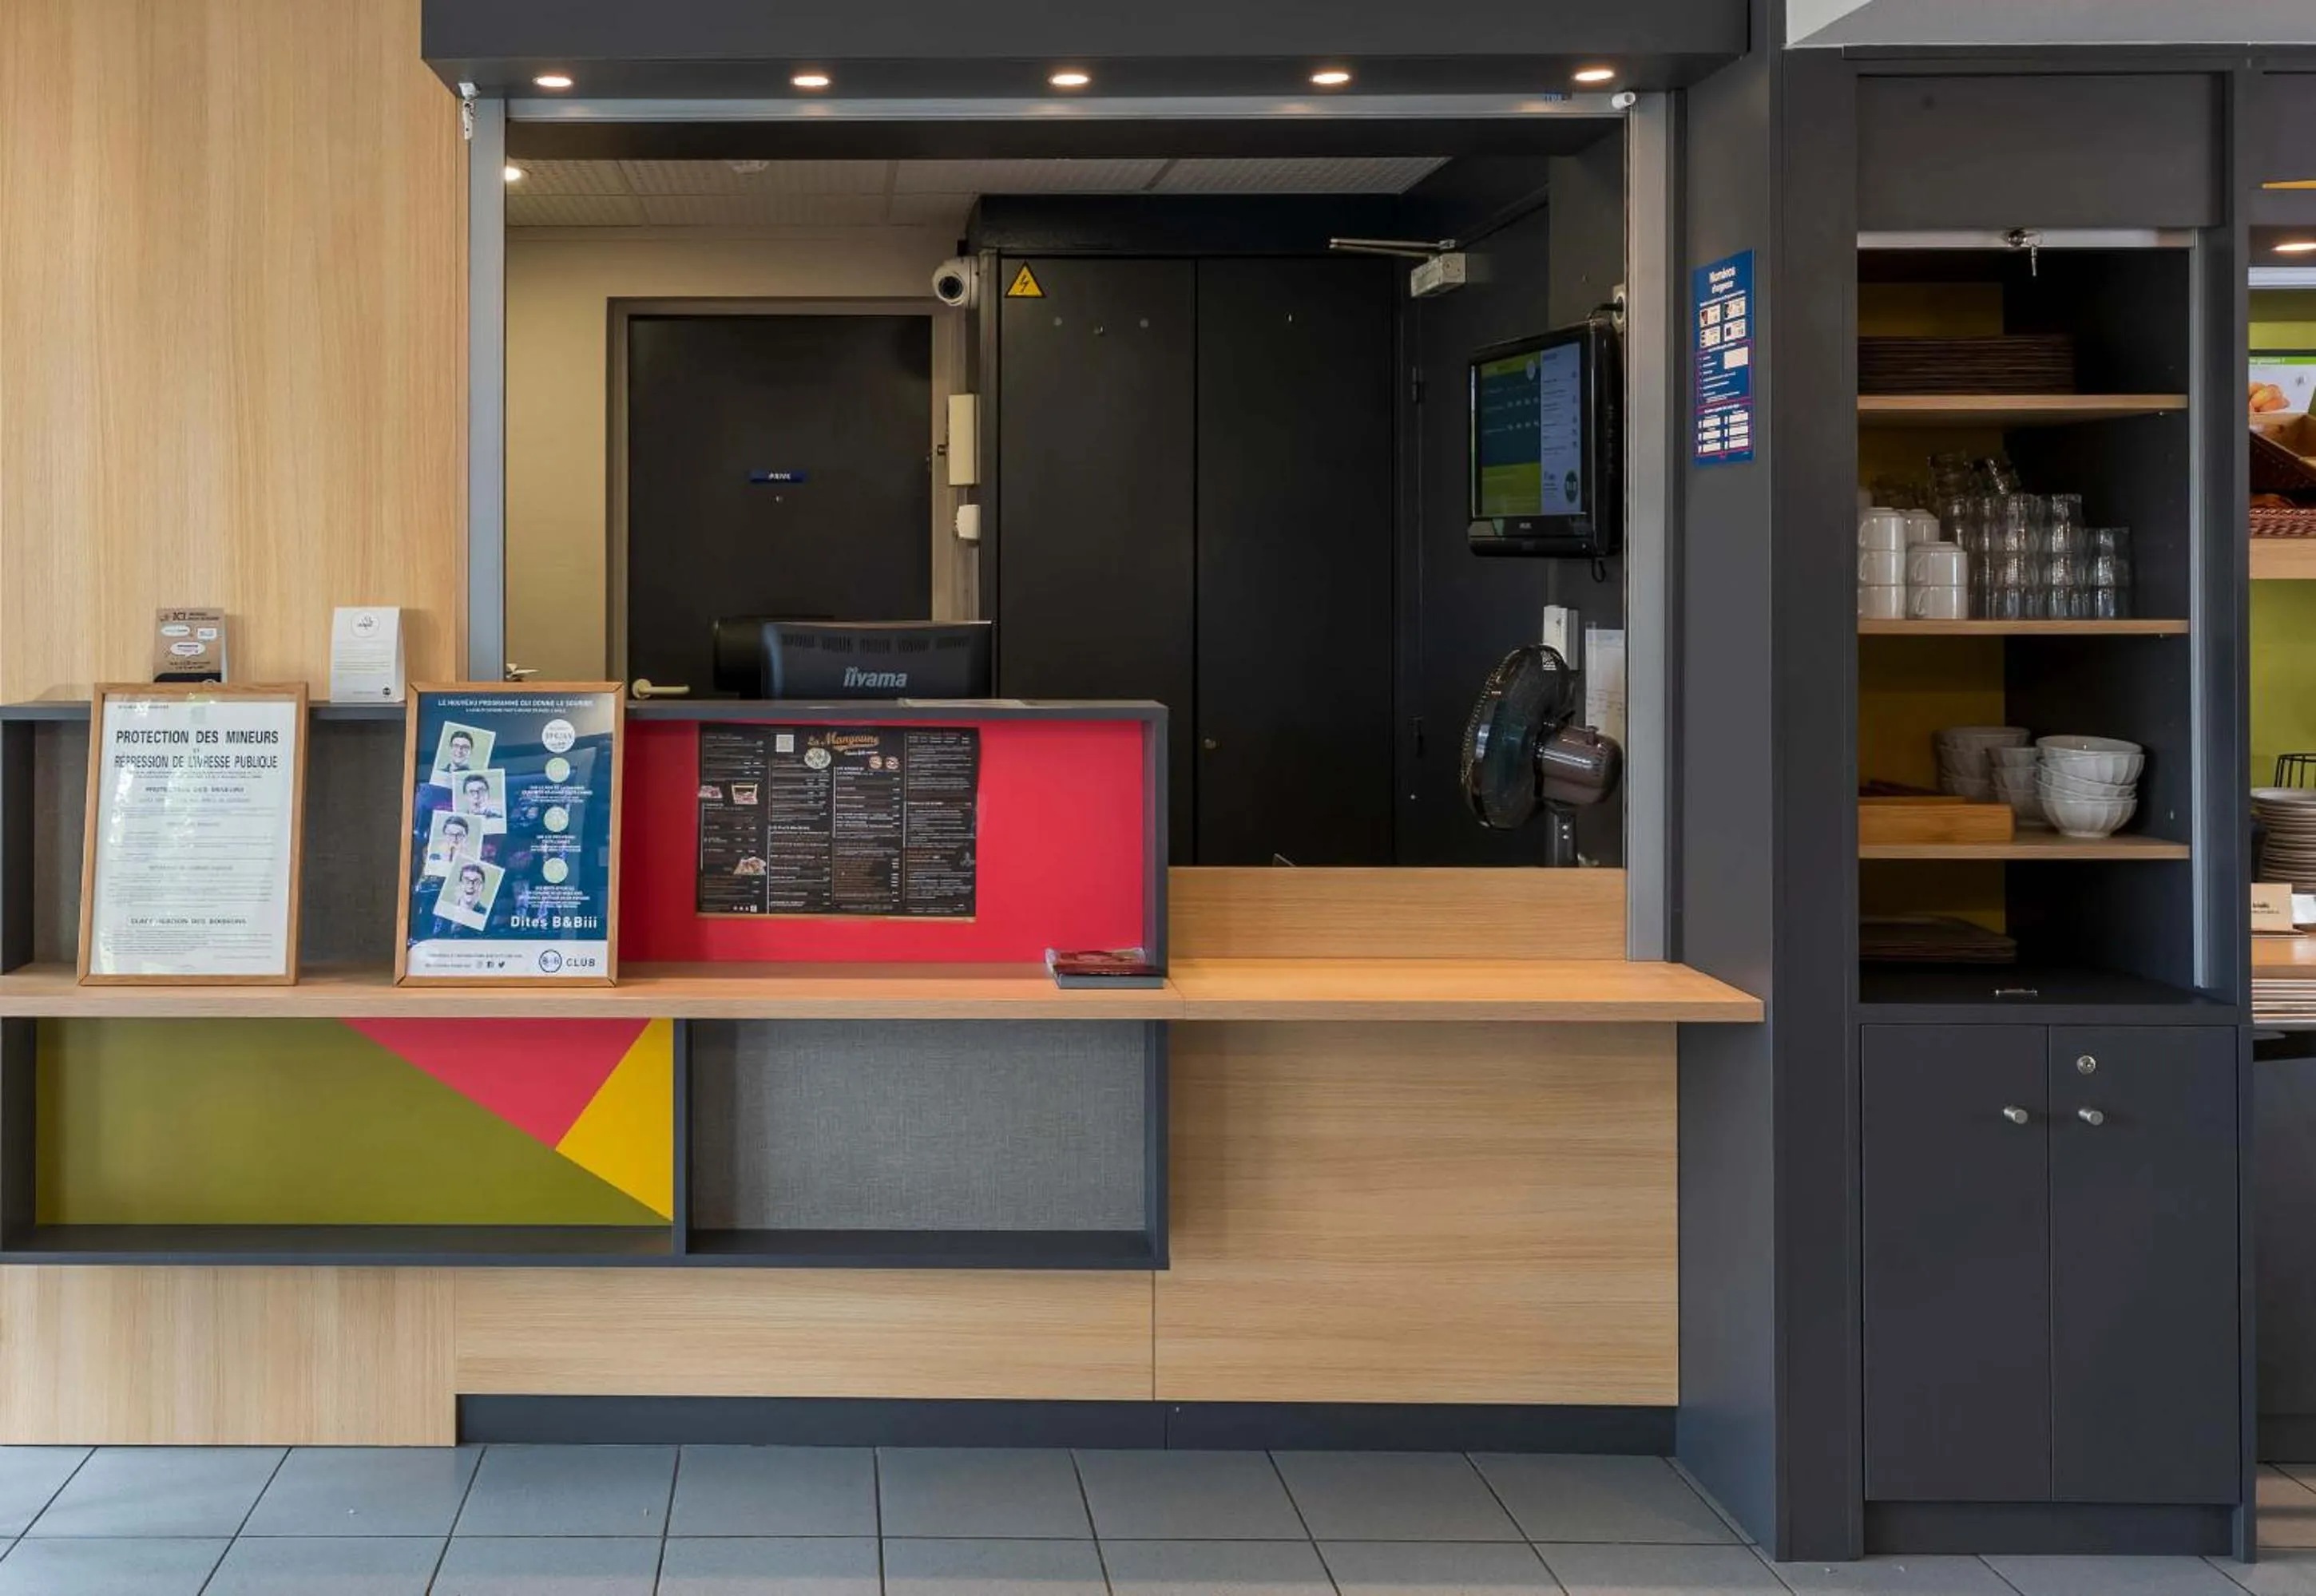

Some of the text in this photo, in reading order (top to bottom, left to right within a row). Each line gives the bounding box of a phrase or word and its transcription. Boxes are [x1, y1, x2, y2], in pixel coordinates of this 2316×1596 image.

[116, 730, 279, 744] PROTECTION DES MINEURS
[173, 755, 184, 768] DE
[234, 755, 279, 768] PUBLIQUE
[510, 916, 547, 929] Dites
[566, 958, 596, 967] CLUB
